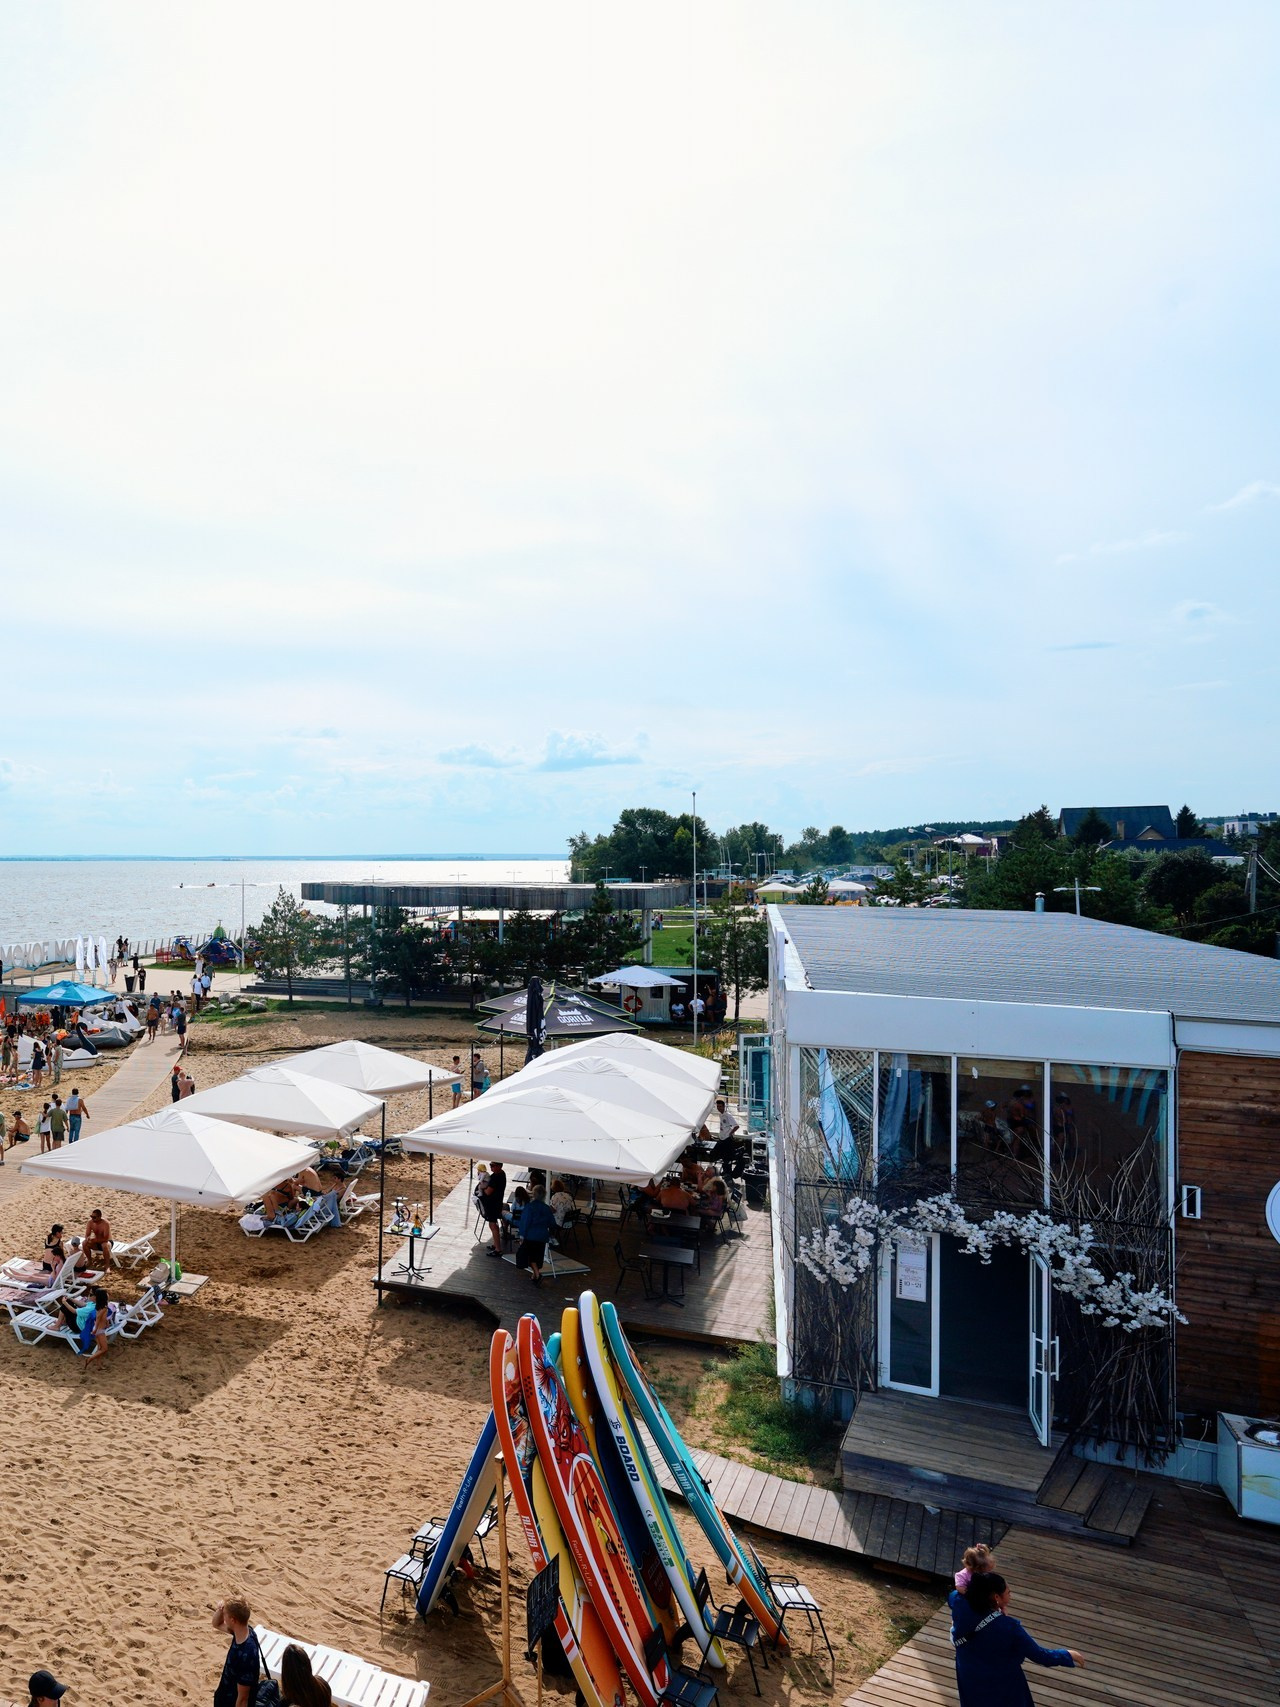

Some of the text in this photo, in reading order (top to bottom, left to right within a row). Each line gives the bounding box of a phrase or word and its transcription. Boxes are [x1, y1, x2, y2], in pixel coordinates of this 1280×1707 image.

[557, 1015, 594, 1024] GORILLA
[616, 1436, 640, 1482] BOARD
[671, 1463, 692, 1490] ALOHA
[521, 1515, 539, 1548] ALOHA
